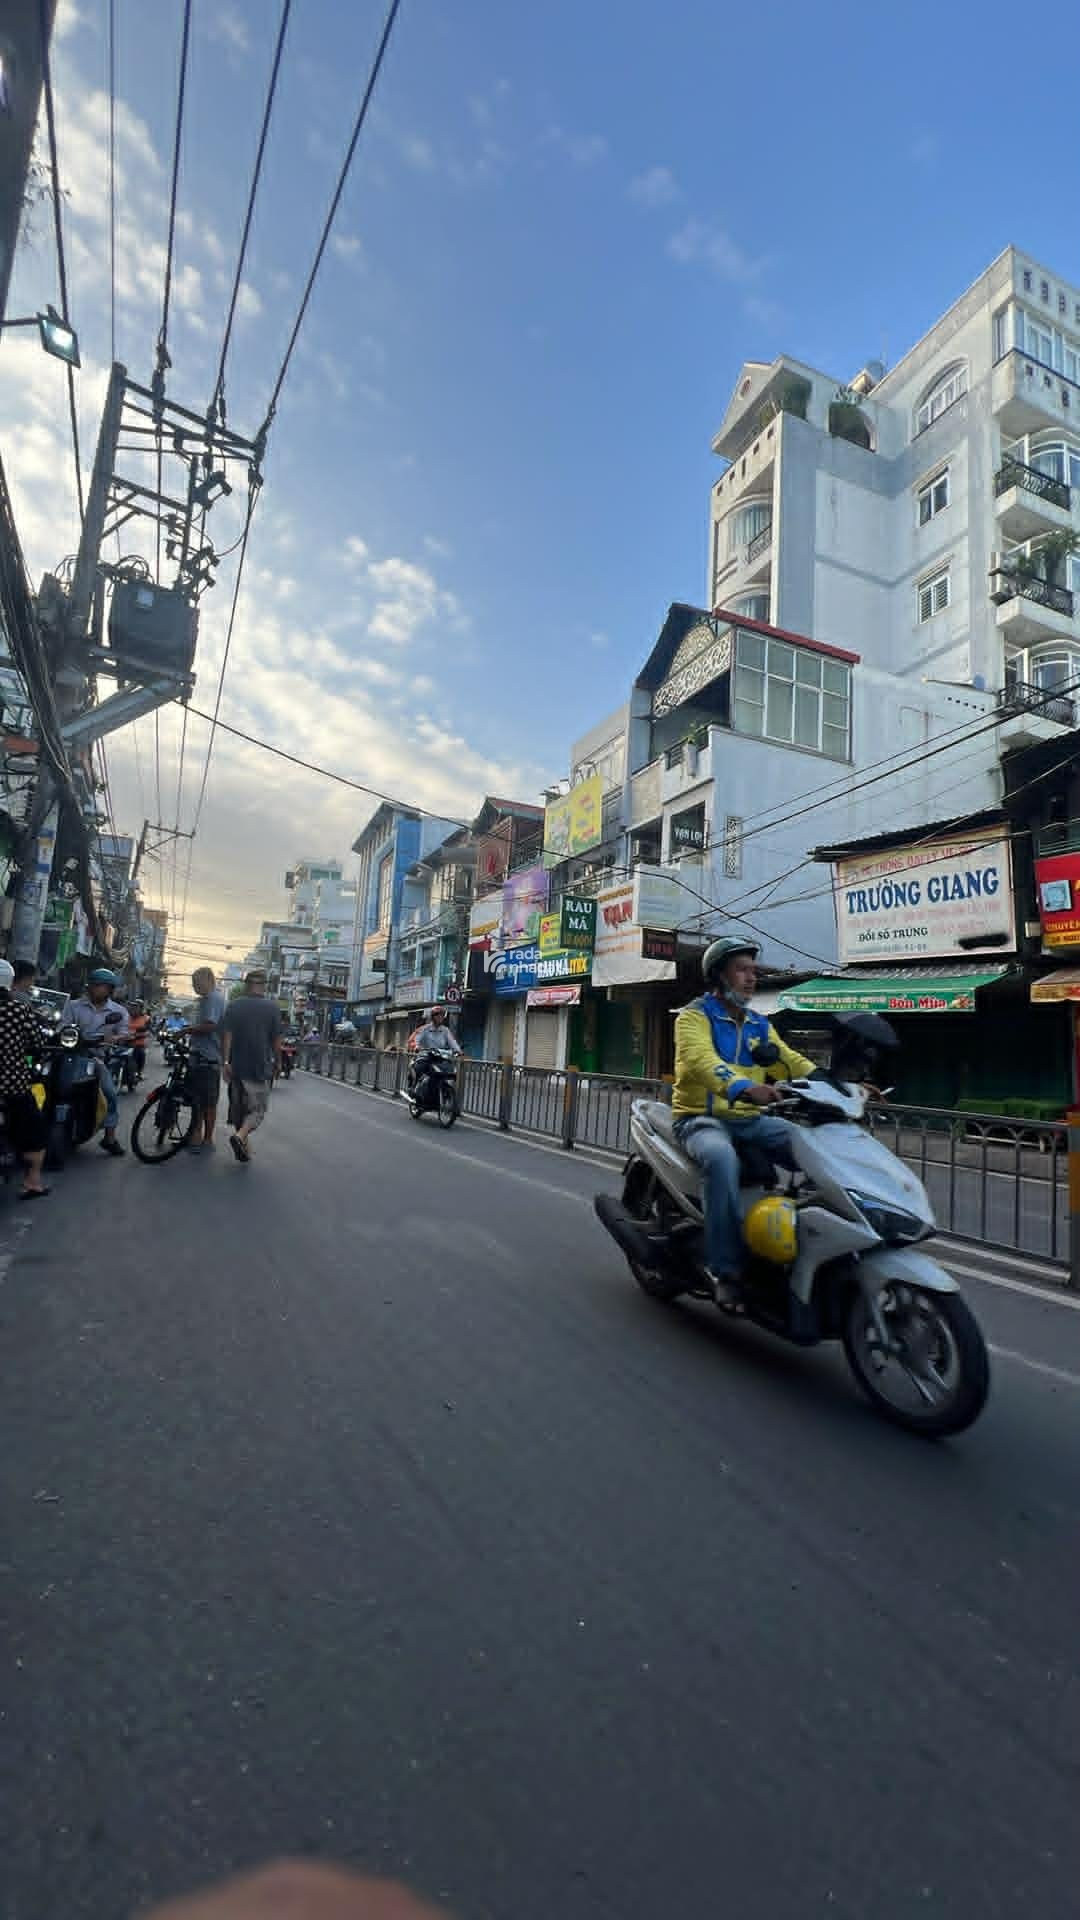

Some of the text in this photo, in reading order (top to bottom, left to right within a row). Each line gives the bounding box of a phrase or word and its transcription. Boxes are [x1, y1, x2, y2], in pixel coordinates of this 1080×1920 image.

[847, 867, 999, 914] TRƯỜNG GIANG
[565, 899, 592, 913] RAU
[568, 916, 588, 930] MÁ
